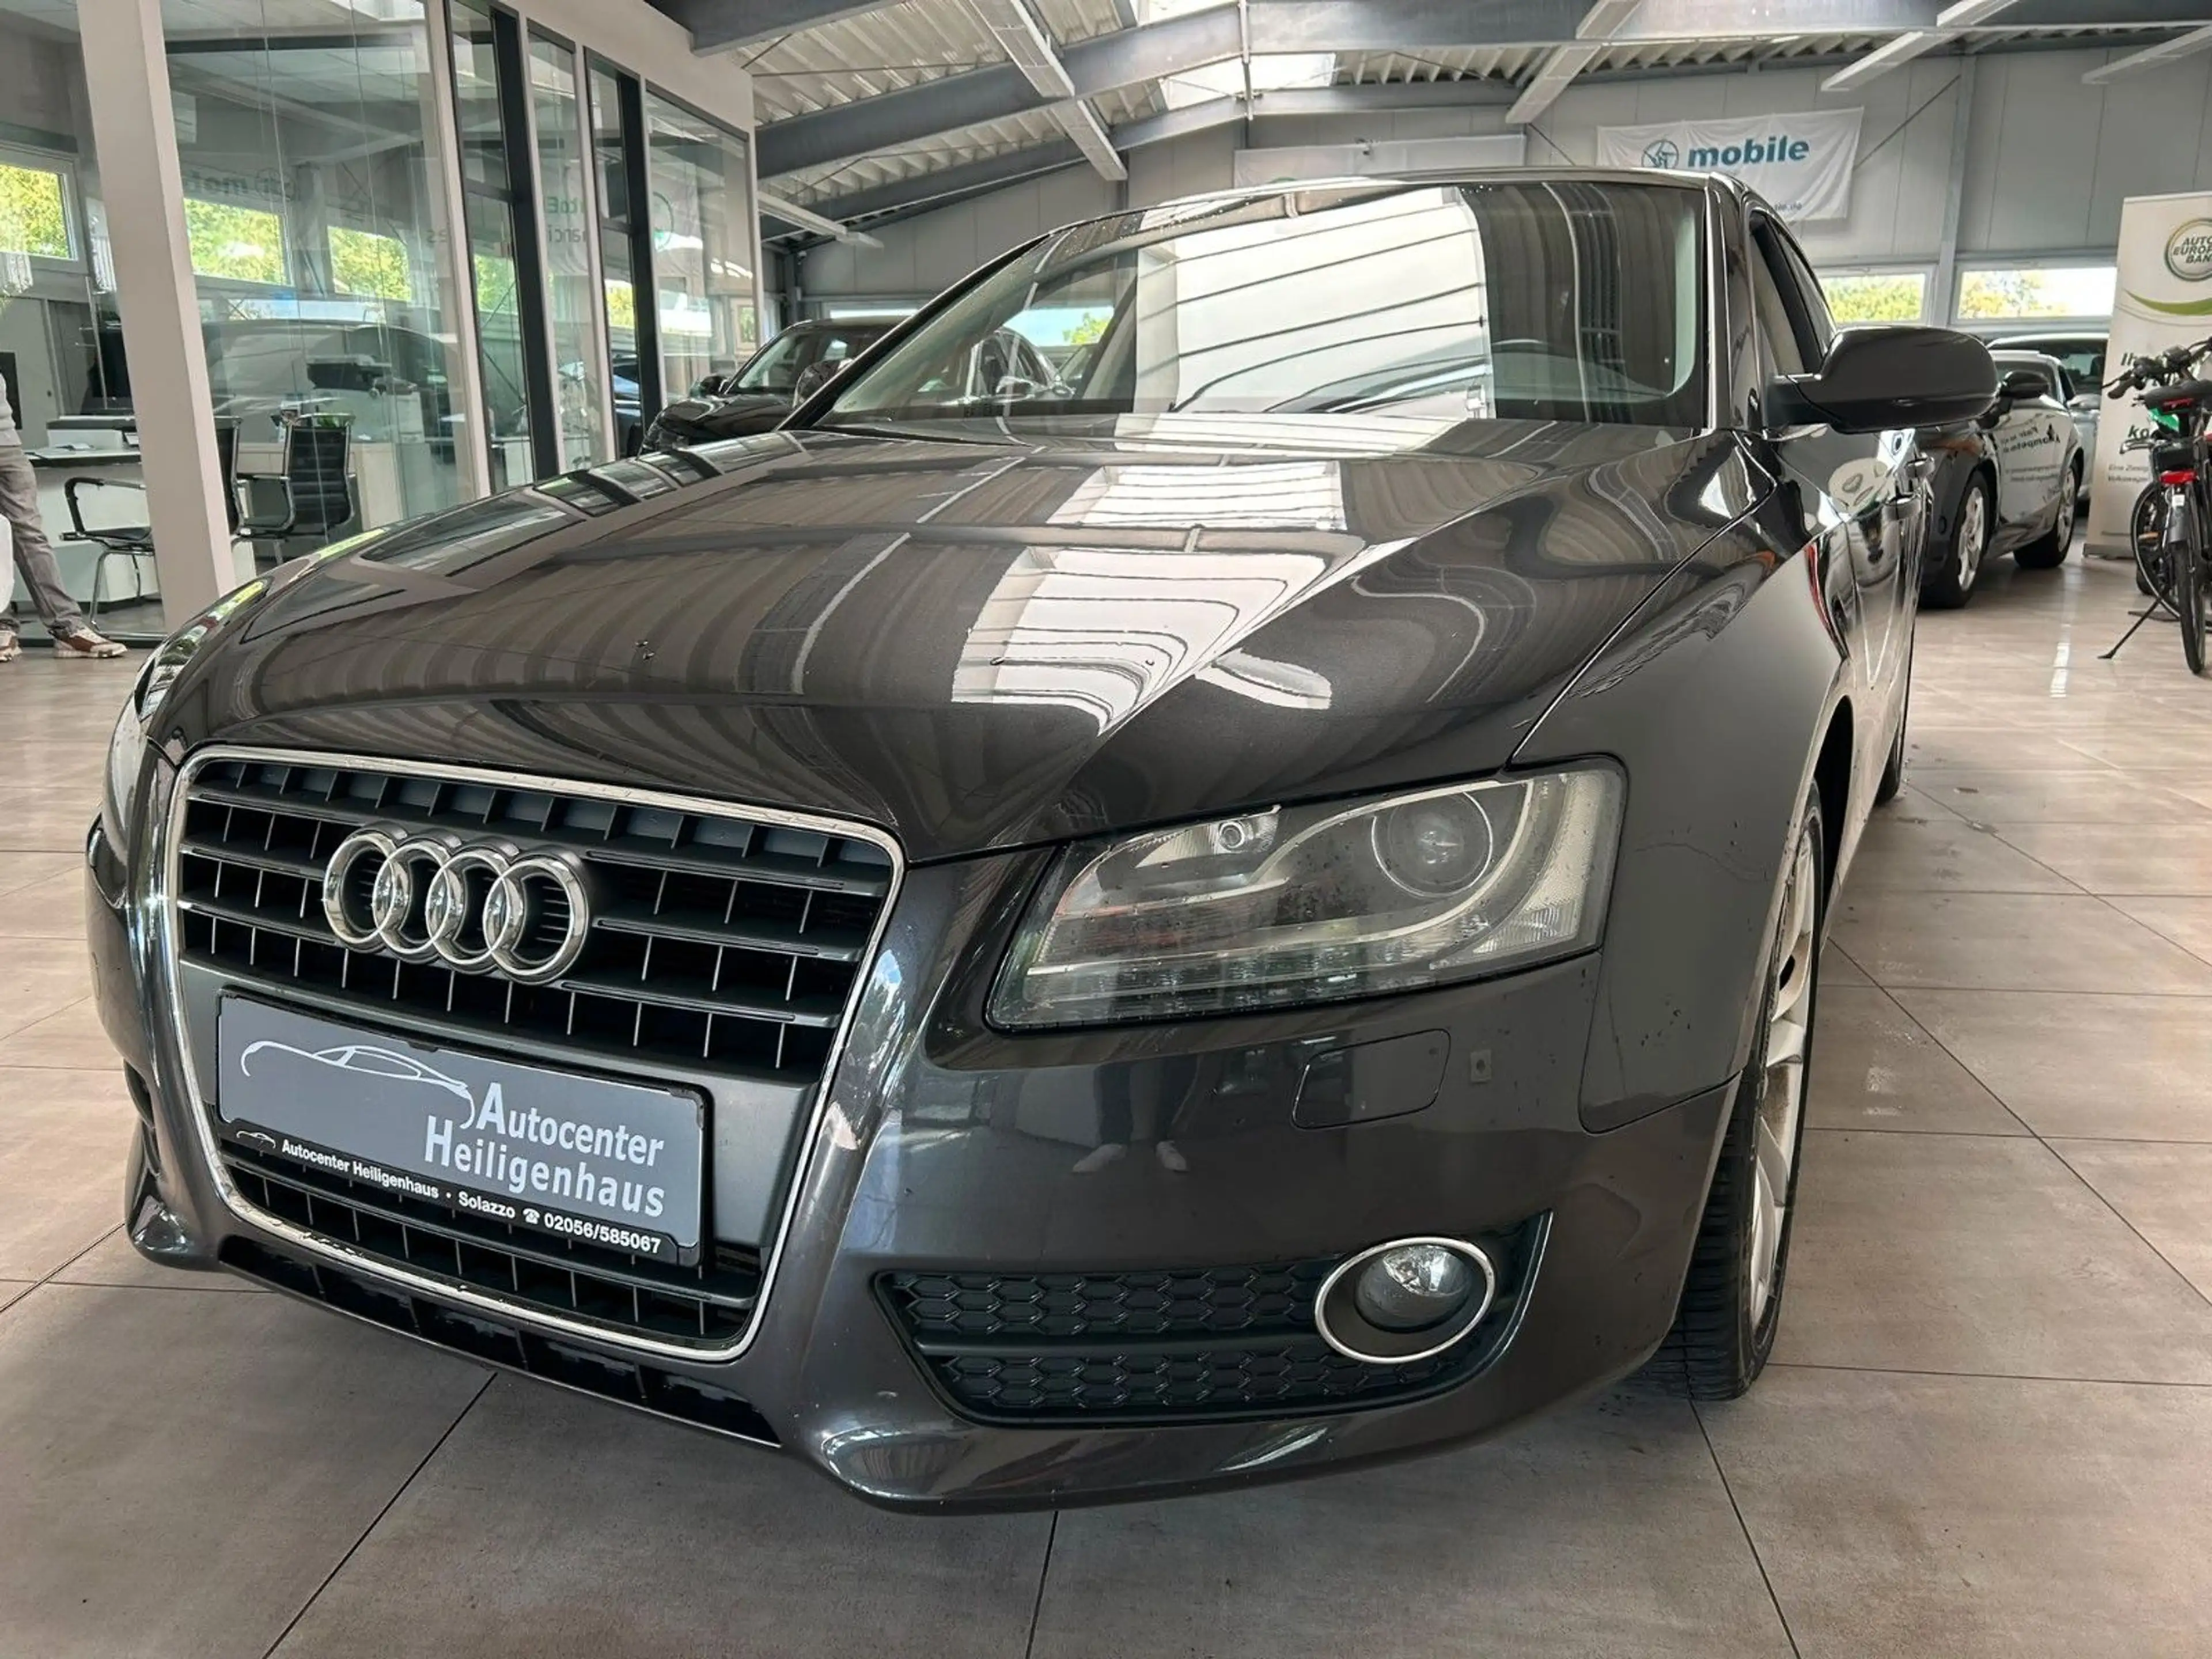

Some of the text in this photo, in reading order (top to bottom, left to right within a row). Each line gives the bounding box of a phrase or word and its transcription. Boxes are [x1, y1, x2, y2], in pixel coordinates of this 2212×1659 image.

[1688, 135, 1809, 168] mobile
[2173, 244, 2212, 256] EUROP
[2186, 252, 2212, 264] BAN
[476, 1082, 665, 1166] Autocenter
[425, 1115, 665, 1218] Heiligenhaus
[282, 1139, 662, 1253] Autocenter Heiligenhaus Solazzo 02056/585067
